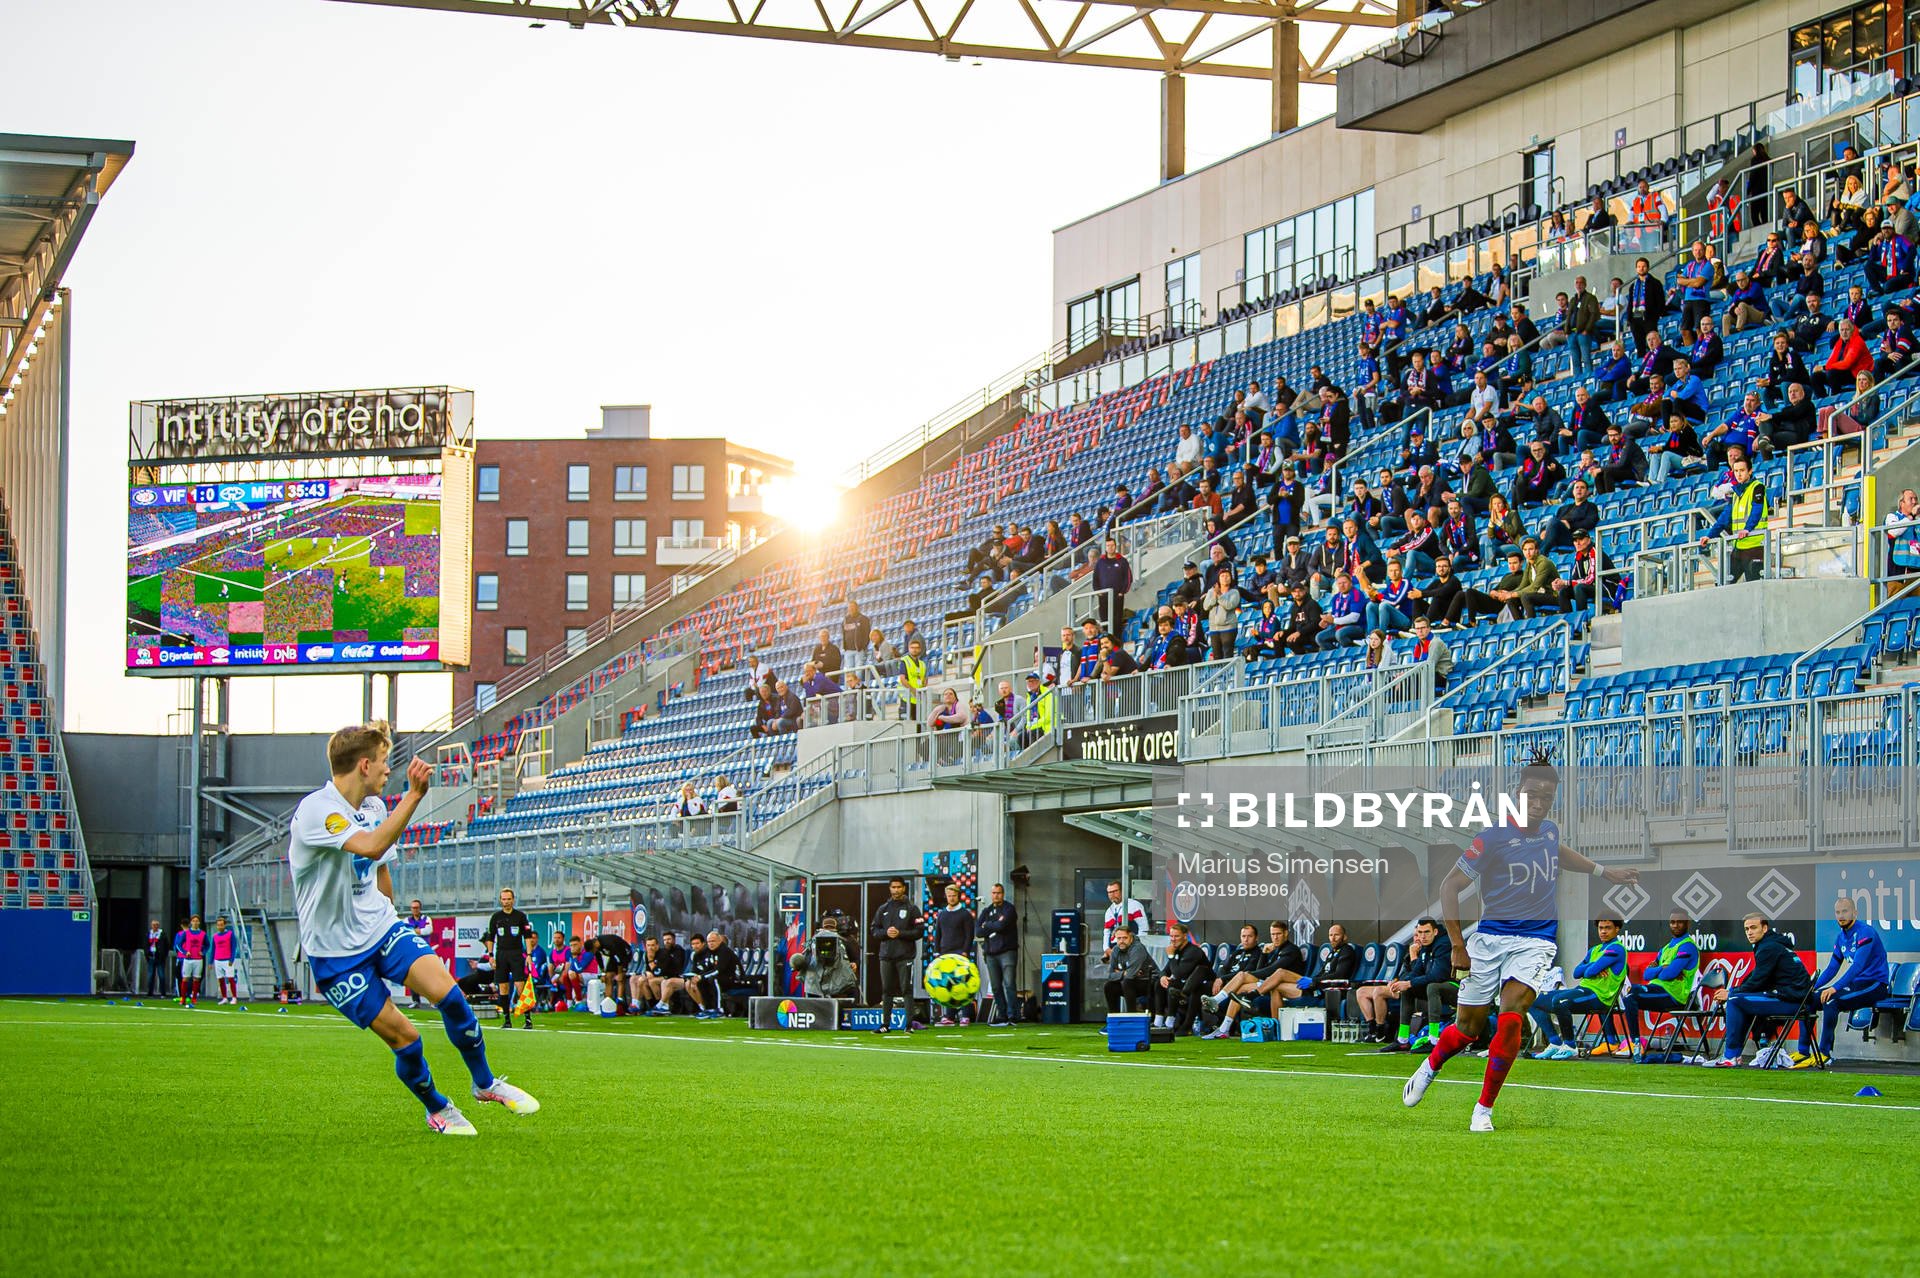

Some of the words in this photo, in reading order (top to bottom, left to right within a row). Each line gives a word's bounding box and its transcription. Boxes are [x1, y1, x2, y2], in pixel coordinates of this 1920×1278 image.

[163, 401, 281, 448] ntility
[302, 402, 425, 436] arena
[162, 489, 186, 503] VIF
[190, 487, 215, 502] 1:0
[251, 485, 284, 500] MFK
[287, 483, 326, 499] 35:43
[234, 648, 269, 660] intility
[273, 646, 297, 663] DNB
[1082, 724, 1139, 763] intility
[787, 1012, 817, 1029] NEP
[853, 1010, 907, 1028] intilty
